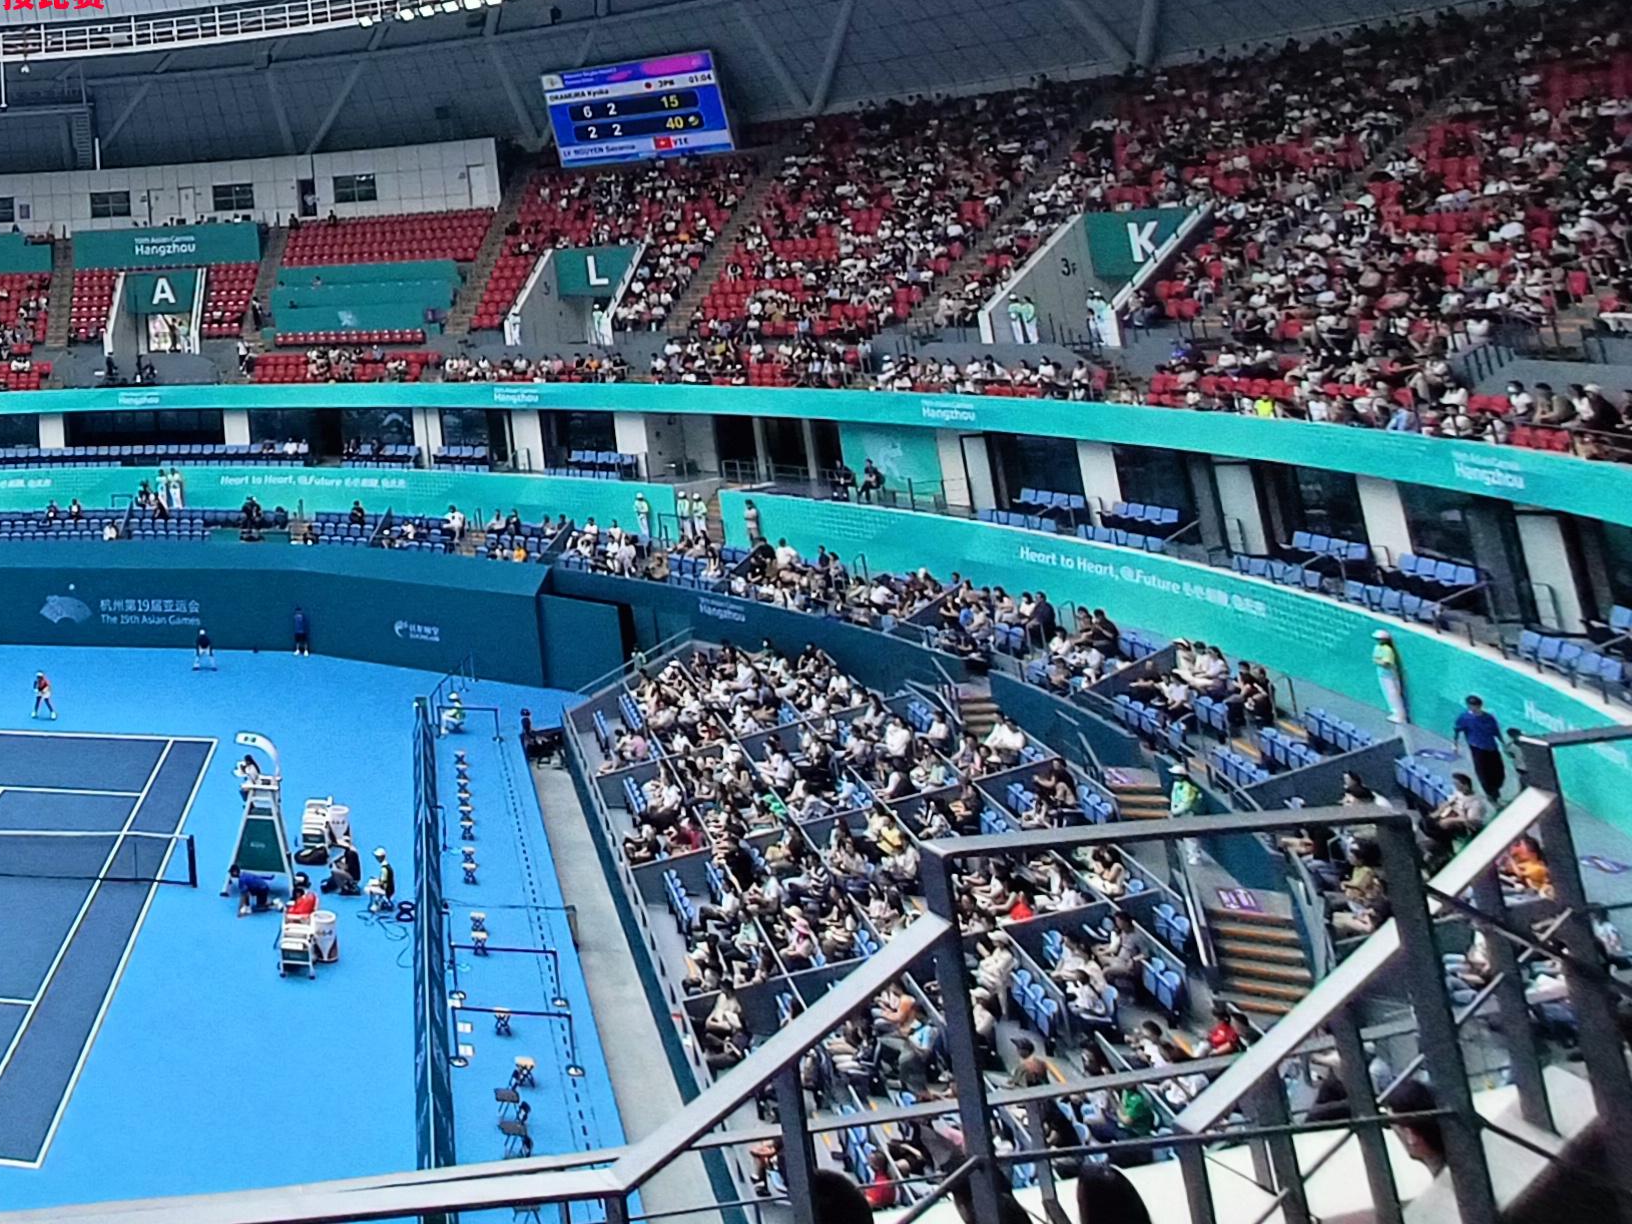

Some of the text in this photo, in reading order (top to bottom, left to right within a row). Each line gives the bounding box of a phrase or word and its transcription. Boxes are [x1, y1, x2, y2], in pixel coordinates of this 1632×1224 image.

[583, 94, 679, 119] 6 2 15
[587, 116, 684, 139] 2 2 40
[135, 242, 196, 256] Hangzhou
[1127, 220, 1158, 263] K
[586, 255, 609, 285] L
[152, 277, 176, 305] A
[1020, 545, 1057, 566] Heart
[1060, 554, 1075, 569] to
